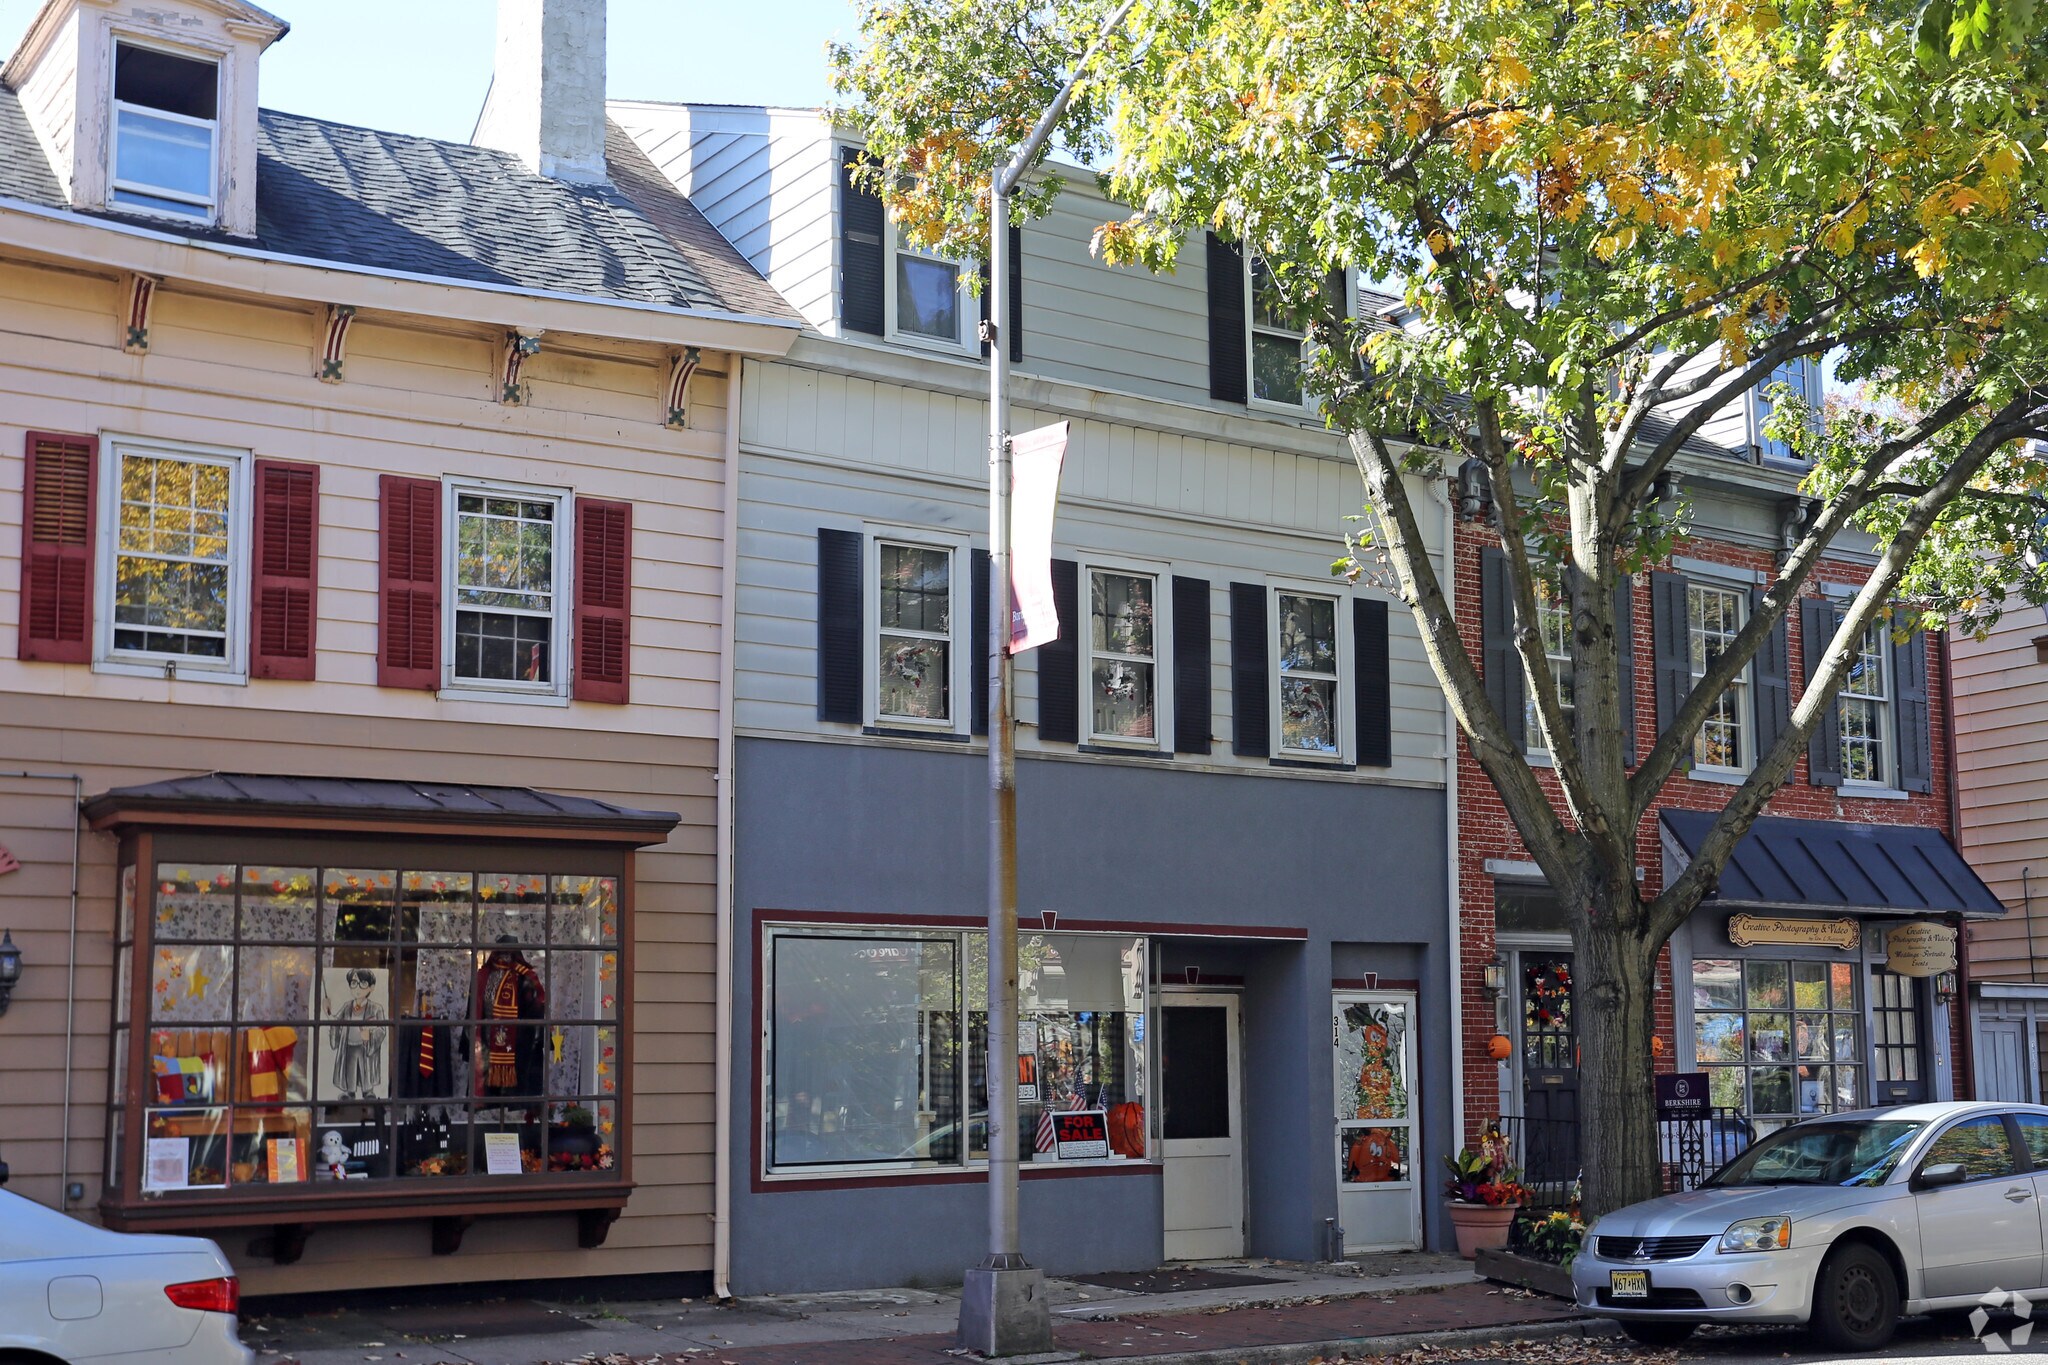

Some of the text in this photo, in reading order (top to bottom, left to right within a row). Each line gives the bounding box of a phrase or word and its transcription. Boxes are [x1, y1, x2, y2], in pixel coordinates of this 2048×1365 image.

[1742, 920, 1848, 935] Creative Photography & Video
[1907, 926, 1931, 935] Creative
[1893, 935, 1926, 944] Photography
[1934, 934, 1950, 942] Video
[1019, 1056, 1034, 1083] NT
[1665, 1099, 1702, 1107] BERKSHIRE
[1064, 1116, 1094, 1128] FOR
[1059, 1129, 1104, 1141] SALE
